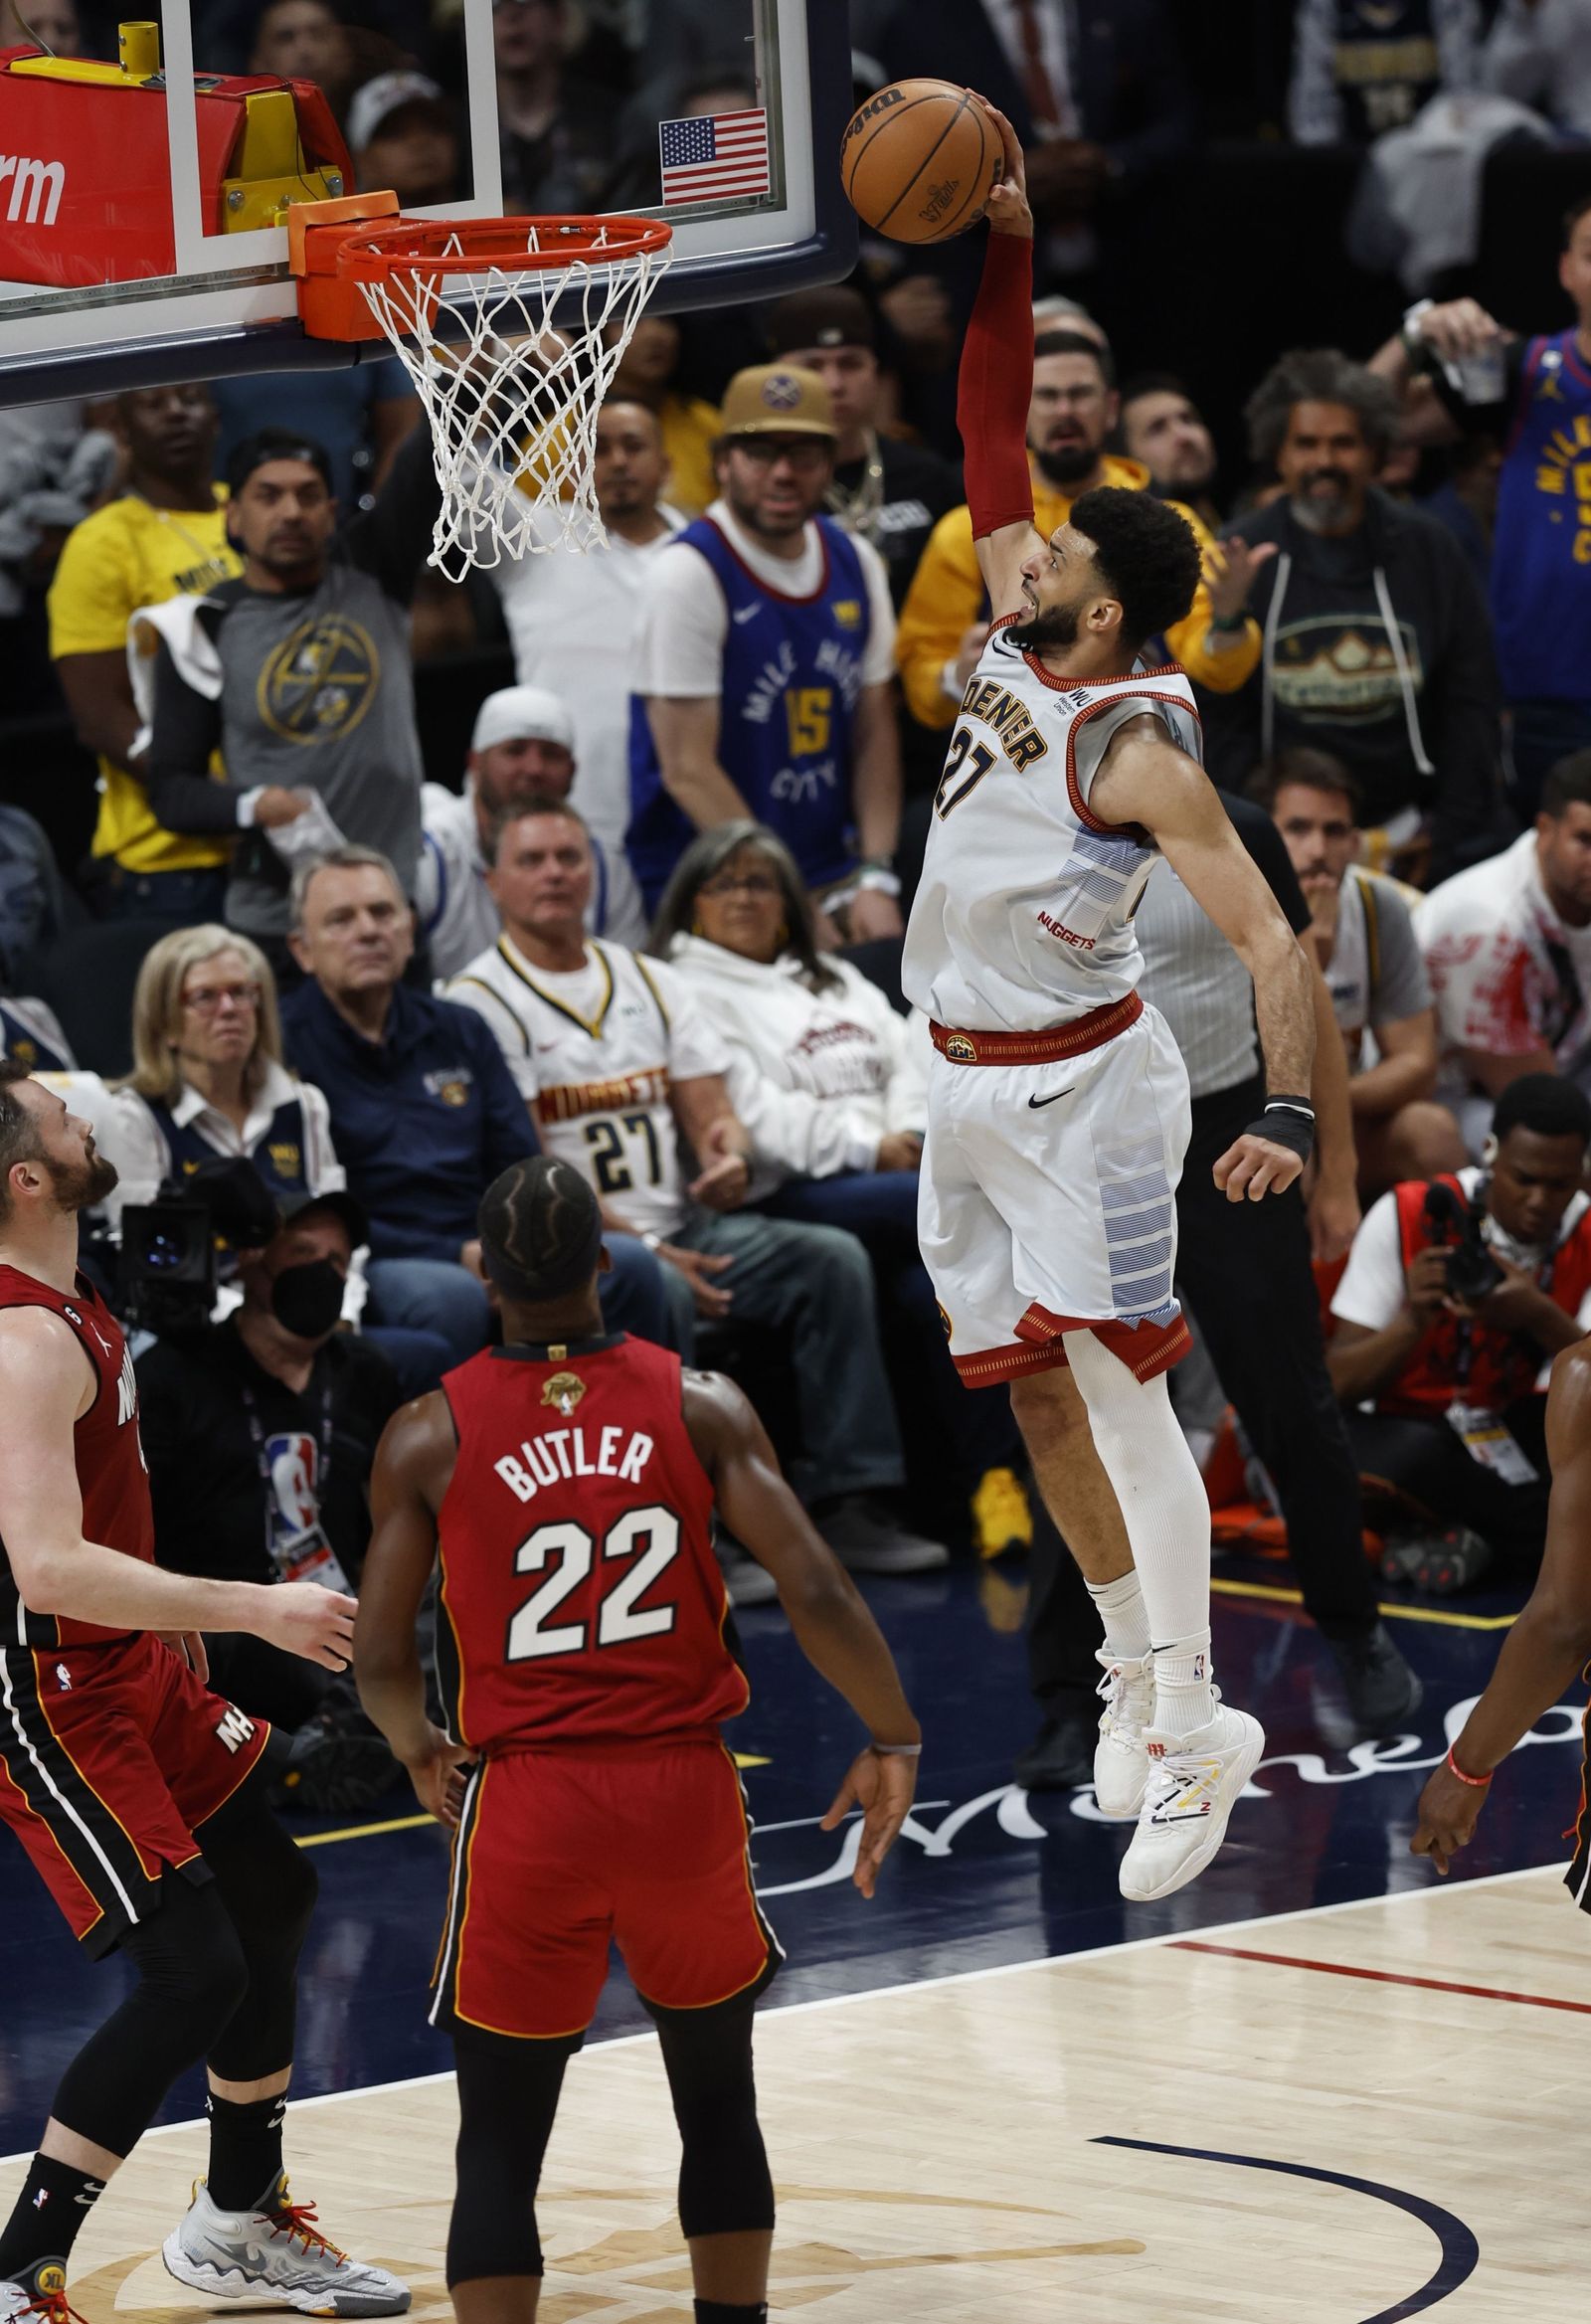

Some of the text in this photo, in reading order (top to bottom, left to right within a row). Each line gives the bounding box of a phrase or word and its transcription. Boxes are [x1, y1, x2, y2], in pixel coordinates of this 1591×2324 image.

[959, 678, 1049, 774] DENER
[1068, 687, 1094, 708] WU
[933, 726, 998, 822] 27
[1036, 910, 1098, 952] NUGGETS
[582, 1108, 664, 1195] 27
[492, 1424, 655, 1505] BUTLER
[505, 1502, 683, 1666] 22
